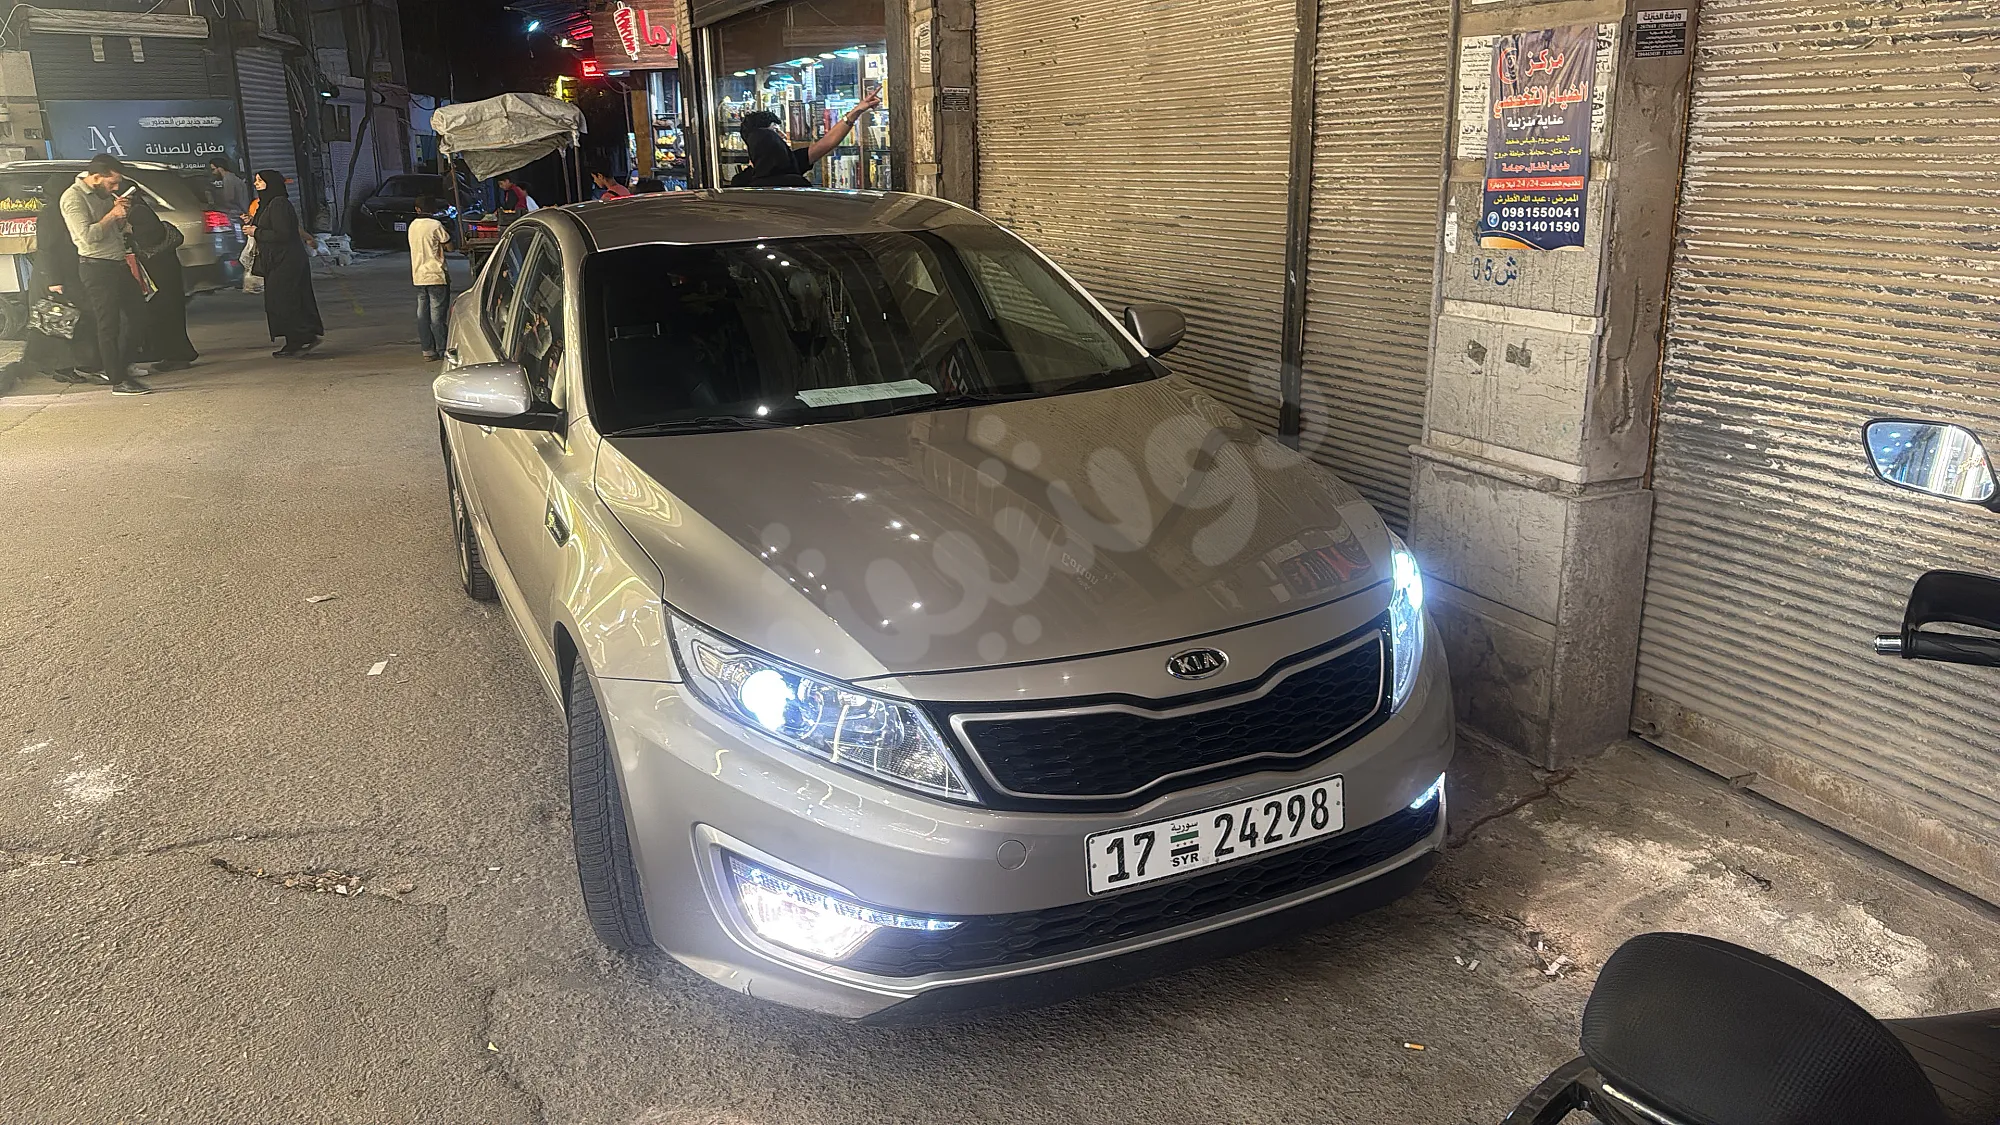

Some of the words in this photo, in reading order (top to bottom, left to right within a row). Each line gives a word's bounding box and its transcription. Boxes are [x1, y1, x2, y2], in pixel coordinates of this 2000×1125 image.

[1525, 49, 1564, 77] مركز
[1493, 85, 1548, 118] التخصصي
[1548, 81, 1589, 110] الضياء
[175, 118, 186, 126] من
[1506, 116, 1536, 130] منزلية
[1537, 115, 1564, 129] عناية
[145, 142, 191, 157] للصيانة
[193, 142, 225, 157] مغلق
[1568, 146, 1582, 156] وسكر
[1539, 179, 1562, 188] الخدمات
[1562, 179, 1581, 188] تقديم
[1493, 193, 1520, 206] الأطرش
[1520, 194, 1531, 203] الله
[1531, 195, 1547, 205] عبد
[1501, 206, 1580, 218] 0981550041
[1501, 220, 1580, 233] 0931401590
[1175, 652, 1220, 674] KIA
[1170, 822, 1199, 833] سورية
[1106, 830, 1156, 884] 17
[1214, 787, 1330, 858] 24298
[1171, 852, 1200, 868] SYR
